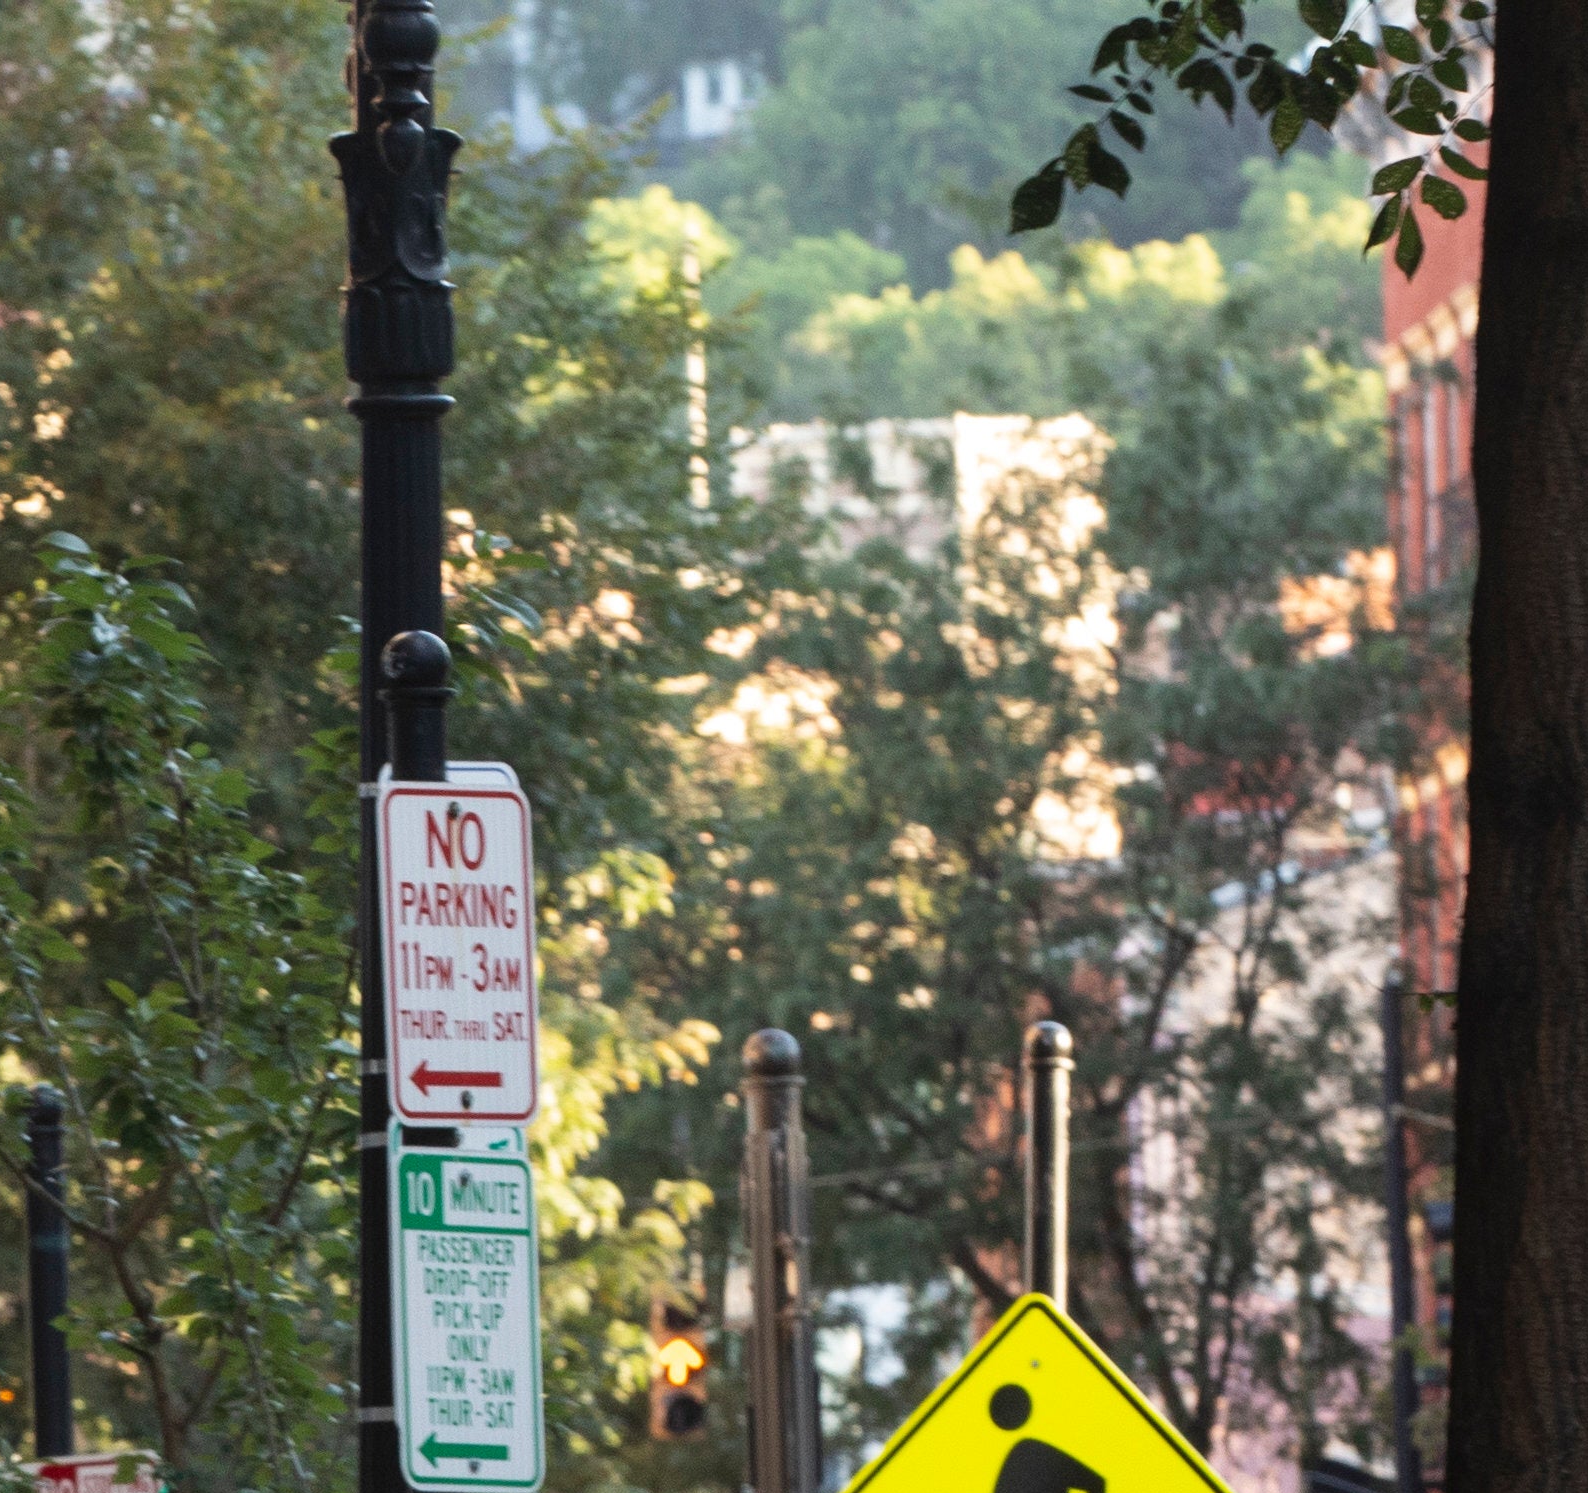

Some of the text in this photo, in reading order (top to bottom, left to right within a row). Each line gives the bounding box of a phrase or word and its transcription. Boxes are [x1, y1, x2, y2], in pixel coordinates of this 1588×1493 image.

[426, 809, 487, 871] NO
[399, 881, 519, 930] PARKING
[454, 1019, 489, 1041] THRU
[405, 1170, 521, 1217] 10 MINUTE
[417, 1233, 515, 1267] PASSENGER
[424, 1266, 510, 1298] DROP-OFF
[432, 1300, 504, 1331] PICK-UP
[446, 1334, 491, 1362] ONLY
